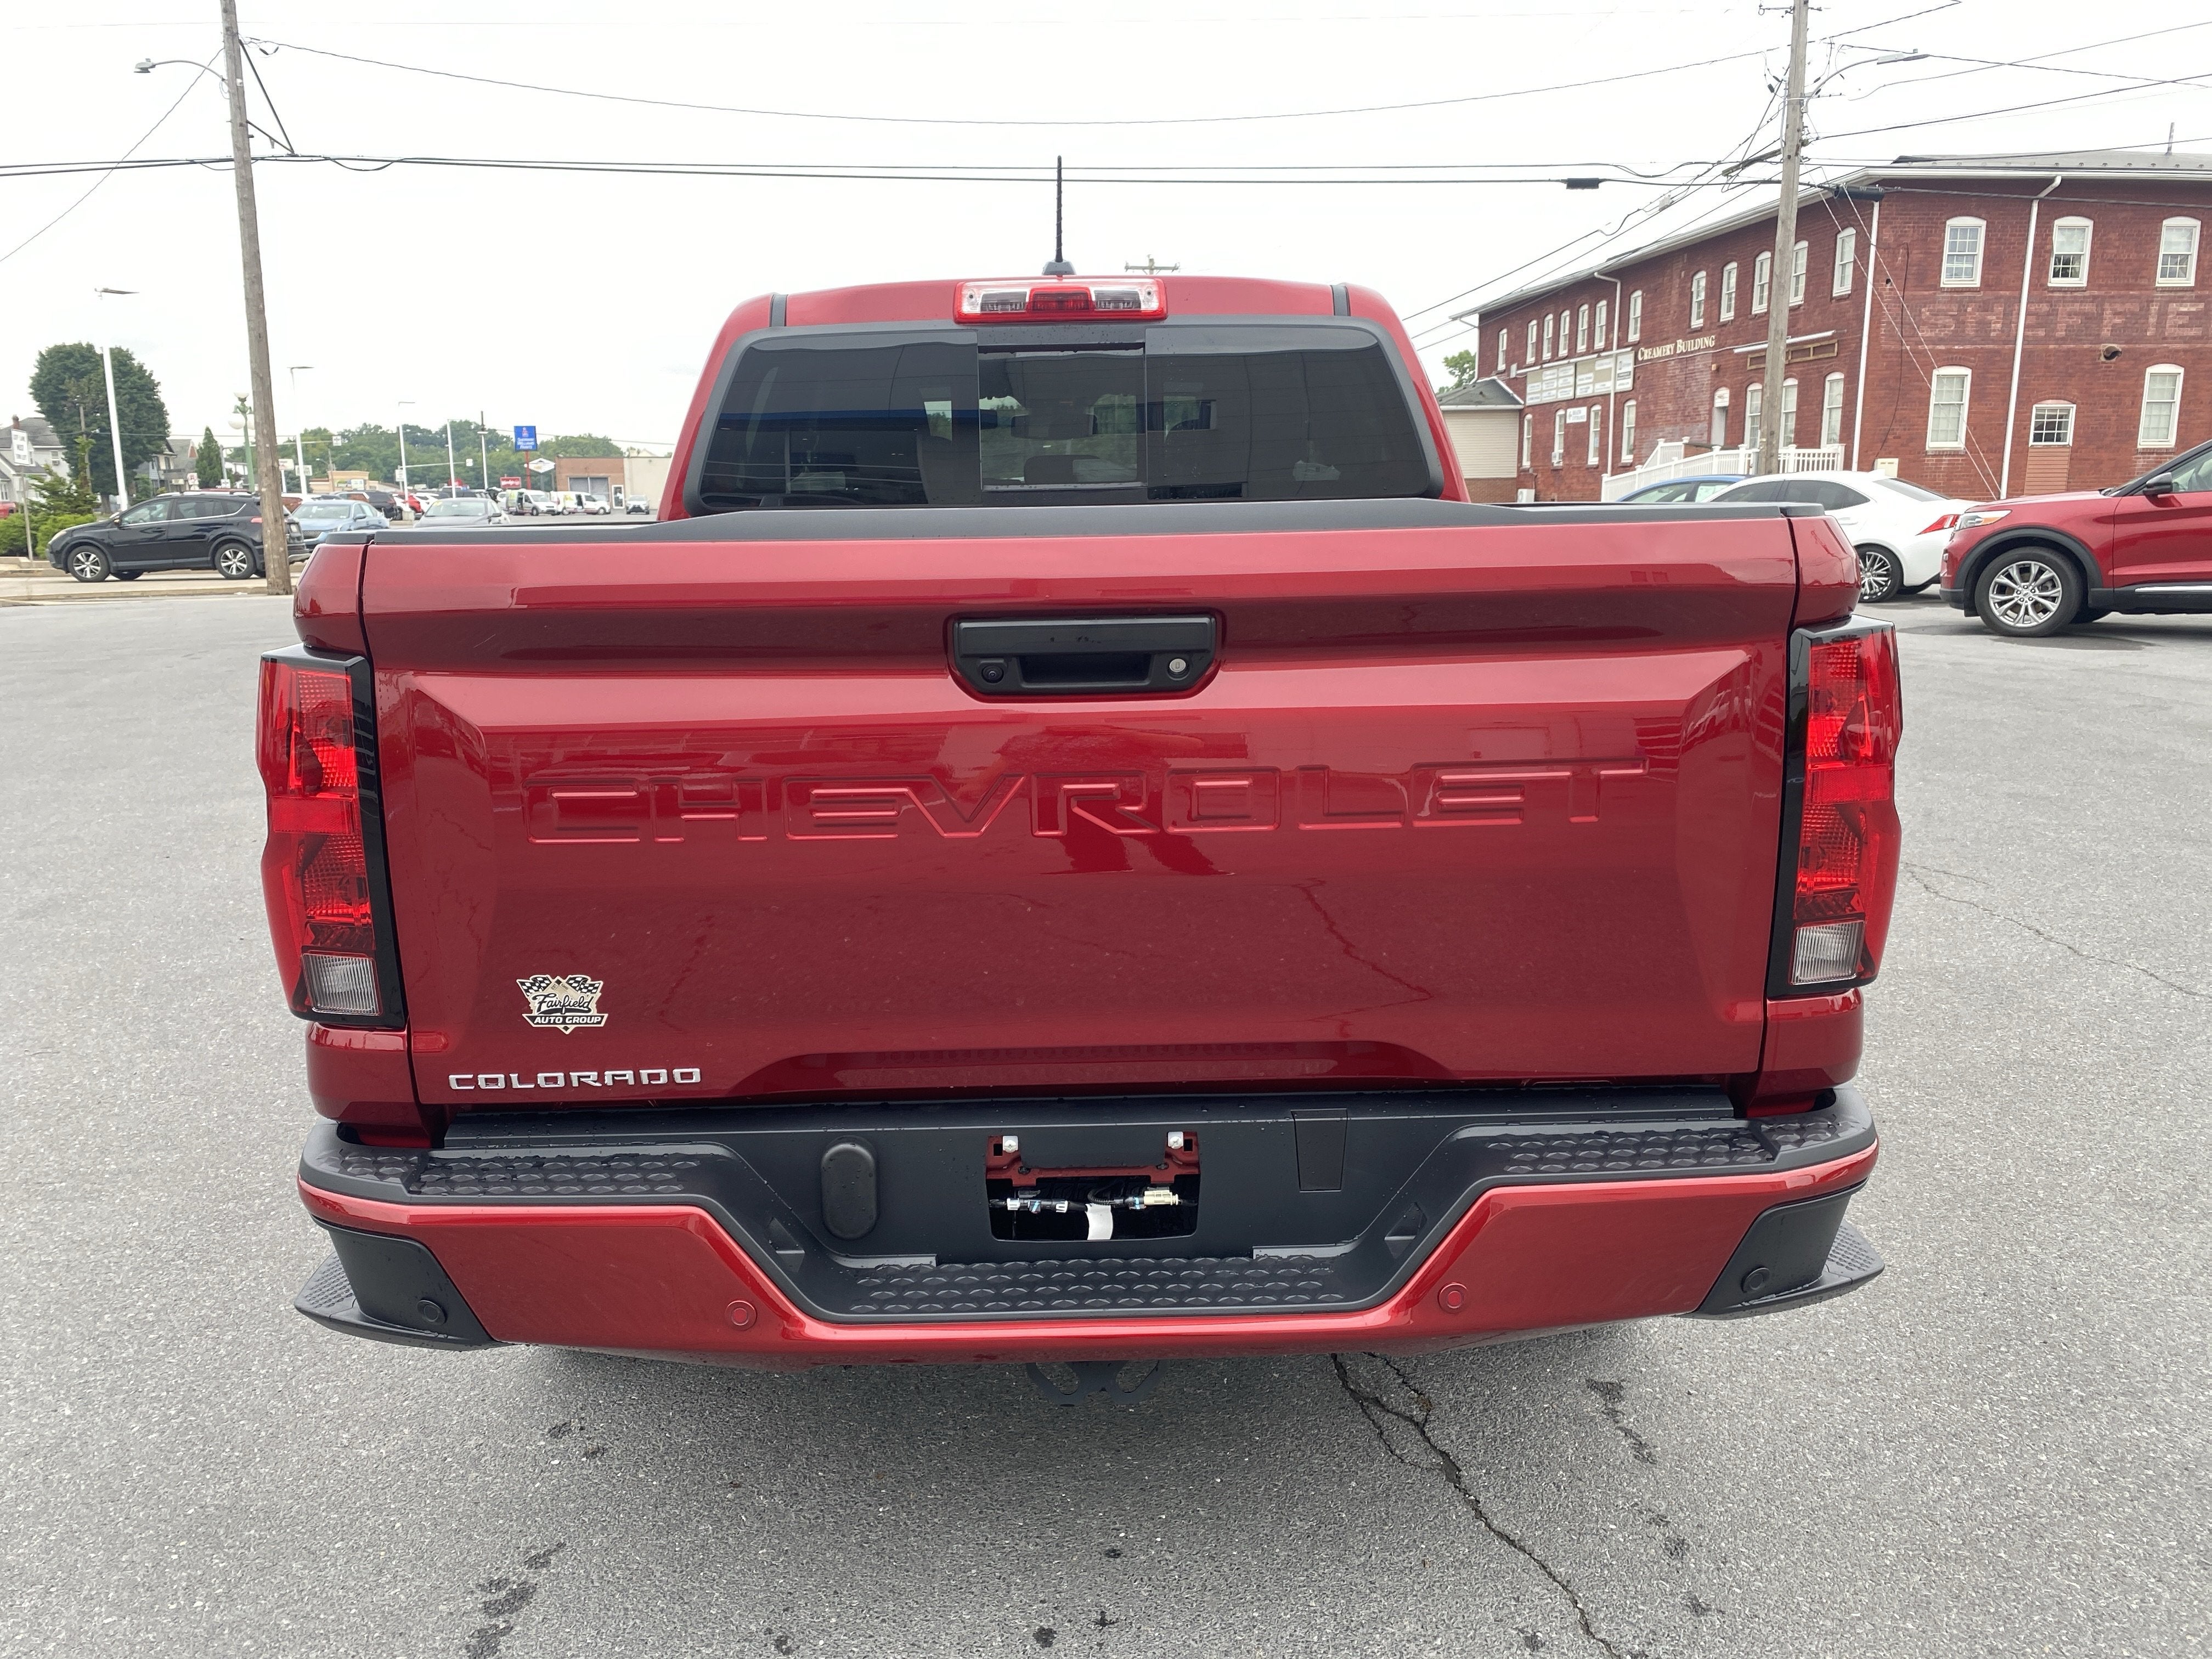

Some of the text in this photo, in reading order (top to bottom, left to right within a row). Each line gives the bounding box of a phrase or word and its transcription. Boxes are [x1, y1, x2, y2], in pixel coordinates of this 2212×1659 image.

[1920, 302, 2211, 337] SHEFFIE
[1639, 335, 1715, 360] CREAMERY BUILDING
[522, 758, 1647, 843] CHEVROLET
[532, 993, 594, 1014] Fairfield
[448, 1068, 701, 1090] COLORADO
